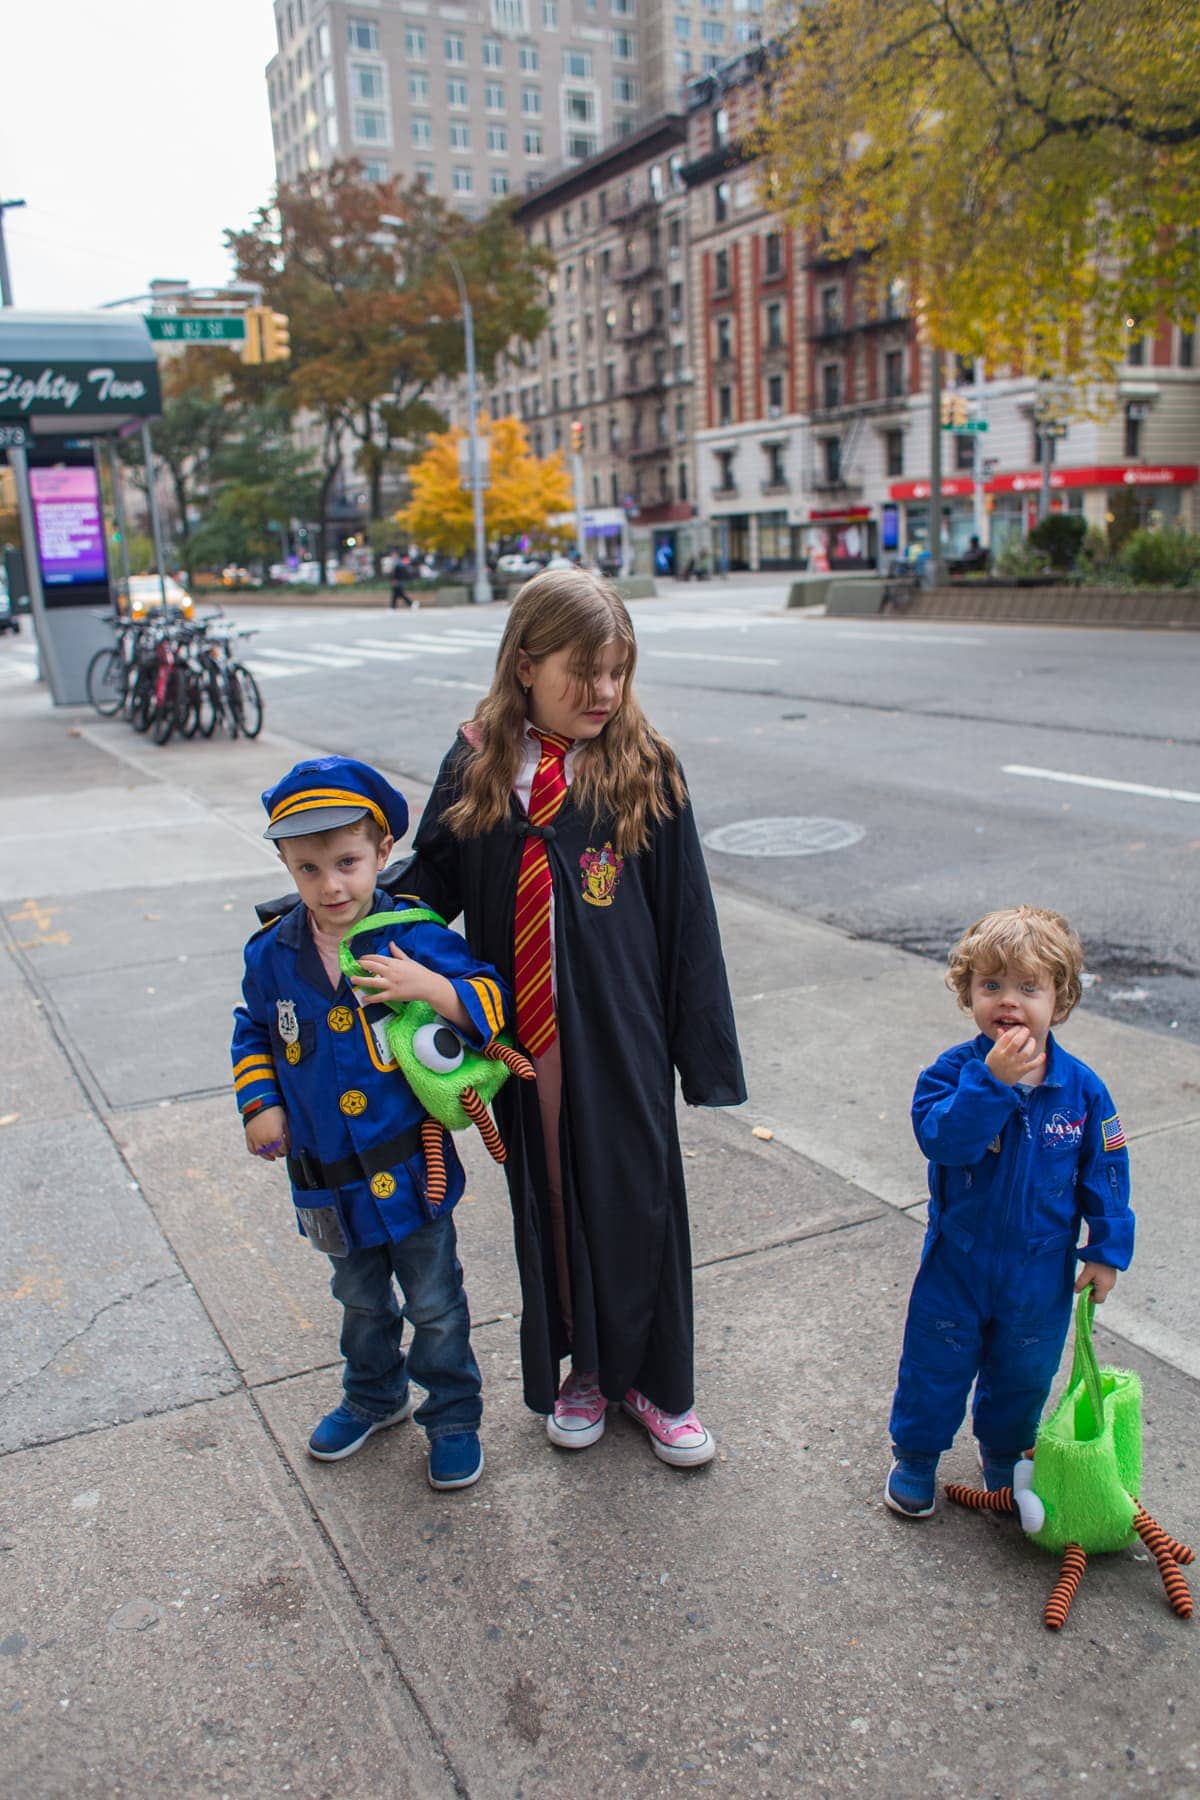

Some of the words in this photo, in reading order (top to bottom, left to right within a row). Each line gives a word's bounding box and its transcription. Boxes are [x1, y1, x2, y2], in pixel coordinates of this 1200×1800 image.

[160, 322, 177, 337] W
[0, 367, 82, 411] Eighty
[87, 367, 146, 402] Two
[1044, 1122, 1082, 1137] NASA
